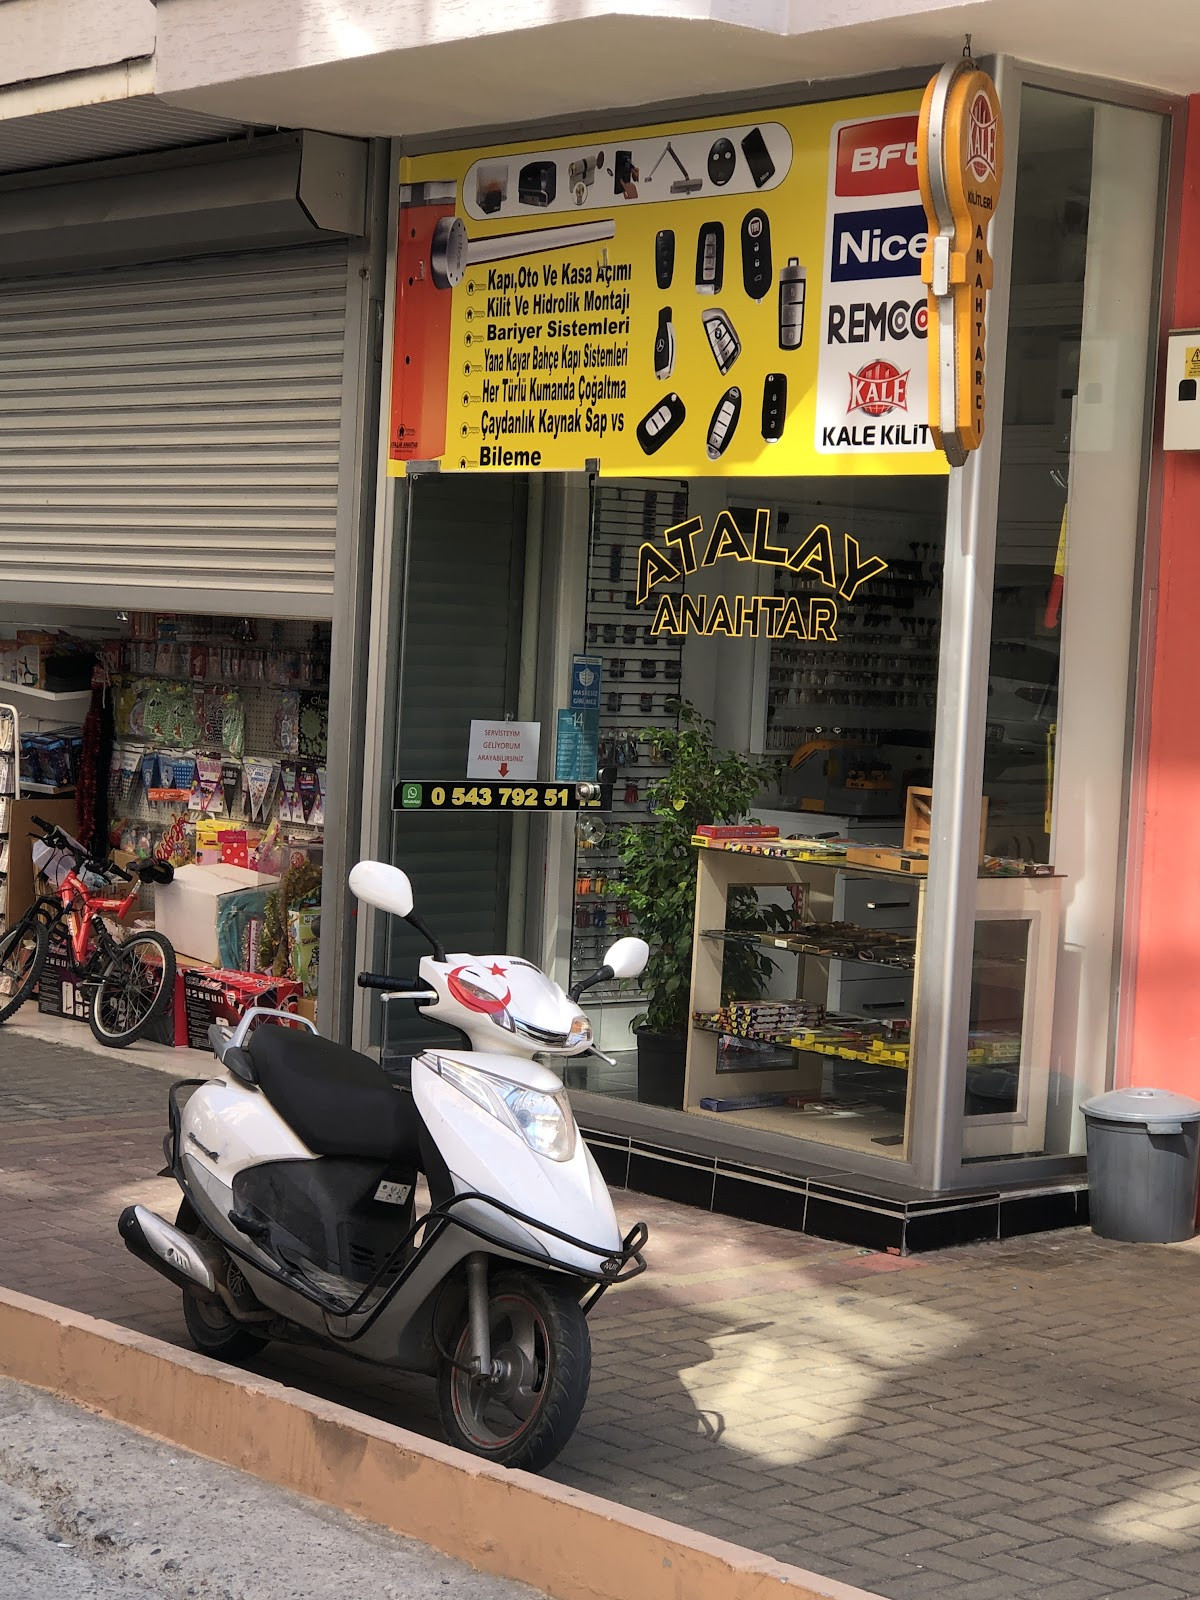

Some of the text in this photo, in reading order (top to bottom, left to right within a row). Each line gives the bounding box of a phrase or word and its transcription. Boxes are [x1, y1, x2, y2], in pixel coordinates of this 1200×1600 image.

[968, 116, 996, 175] KALE
[839, 228, 929, 265] Nice
[543, 264, 557, 286] Ve
[562, 263, 592, 285] Kasa
[487, 288, 630, 317] Kilit Ve Hidrolik Montajı
[487, 316, 630, 344] Bariyer Sistemleri
[484, 341, 628, 377] Yana Kayar Bahçe Kapı Sistemleri
[482, 374, 626, 406] Her Türlü Kumanda Çoğaltma
[851, 372, 909, 410] KALE
[481, 407, 624, 440] Çaydanlık Kaynak Sap vs
[822, 425, 876, 446] KALE
[480, 446, 541, 466] Bileme
[636, 508, 889, 605] ATALAY
[650, 594, 838, 641] ANAHTAR
[572, 712, 584, 727] 14
[483, 740, 521, 750] GELİYORUM
[431, 787, 569, 807] 0 543 792 51
